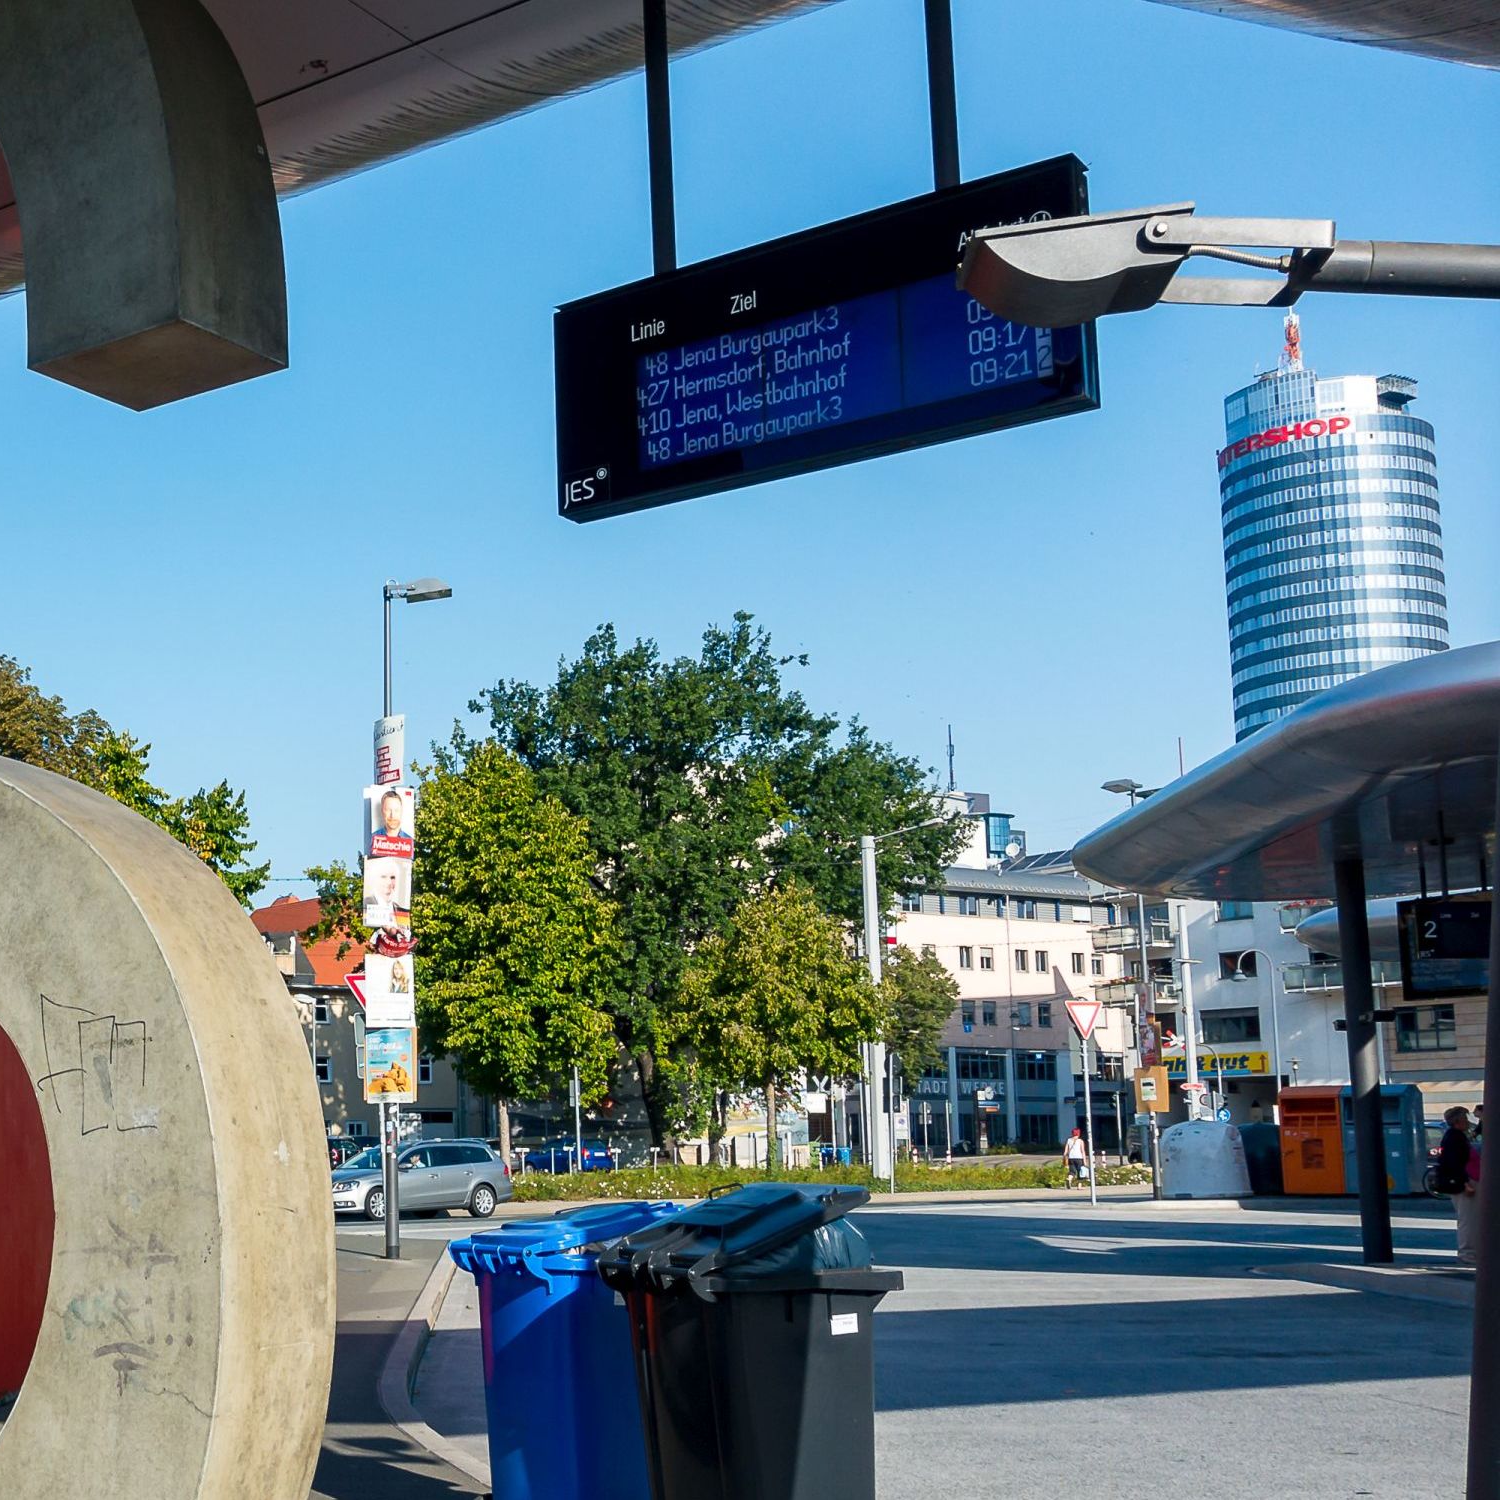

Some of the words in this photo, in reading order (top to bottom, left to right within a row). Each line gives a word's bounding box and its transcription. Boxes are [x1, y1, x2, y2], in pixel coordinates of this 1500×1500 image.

[631, 319, 665, 342] Linie
[730, 290, 757, 315] Ziel
[645, 352, 668, 377] 48
[674, 347, 716, 371] Jena
[720, 305, 840, 354] Burgaupark3
[636, 379, 669, 408] 427
[674, 356, 771, 400] Hermsdorf,
[775, 332, 851, 373] Bahnhof
[637, 411, 671, 437] 410
[675, 403, 723, 428] Jena,
[727, 364, 847, 415] Westbahnhof
[648, 437, 670, 462] 48
[676, 432, 718, 457] Jena
[722, 395, 842, 444] Burgaupark3
[970, 350, 1033, 386] 09:21
[563, 477, 595, 509] JES
[1424, 921, 1437, 938] 2
